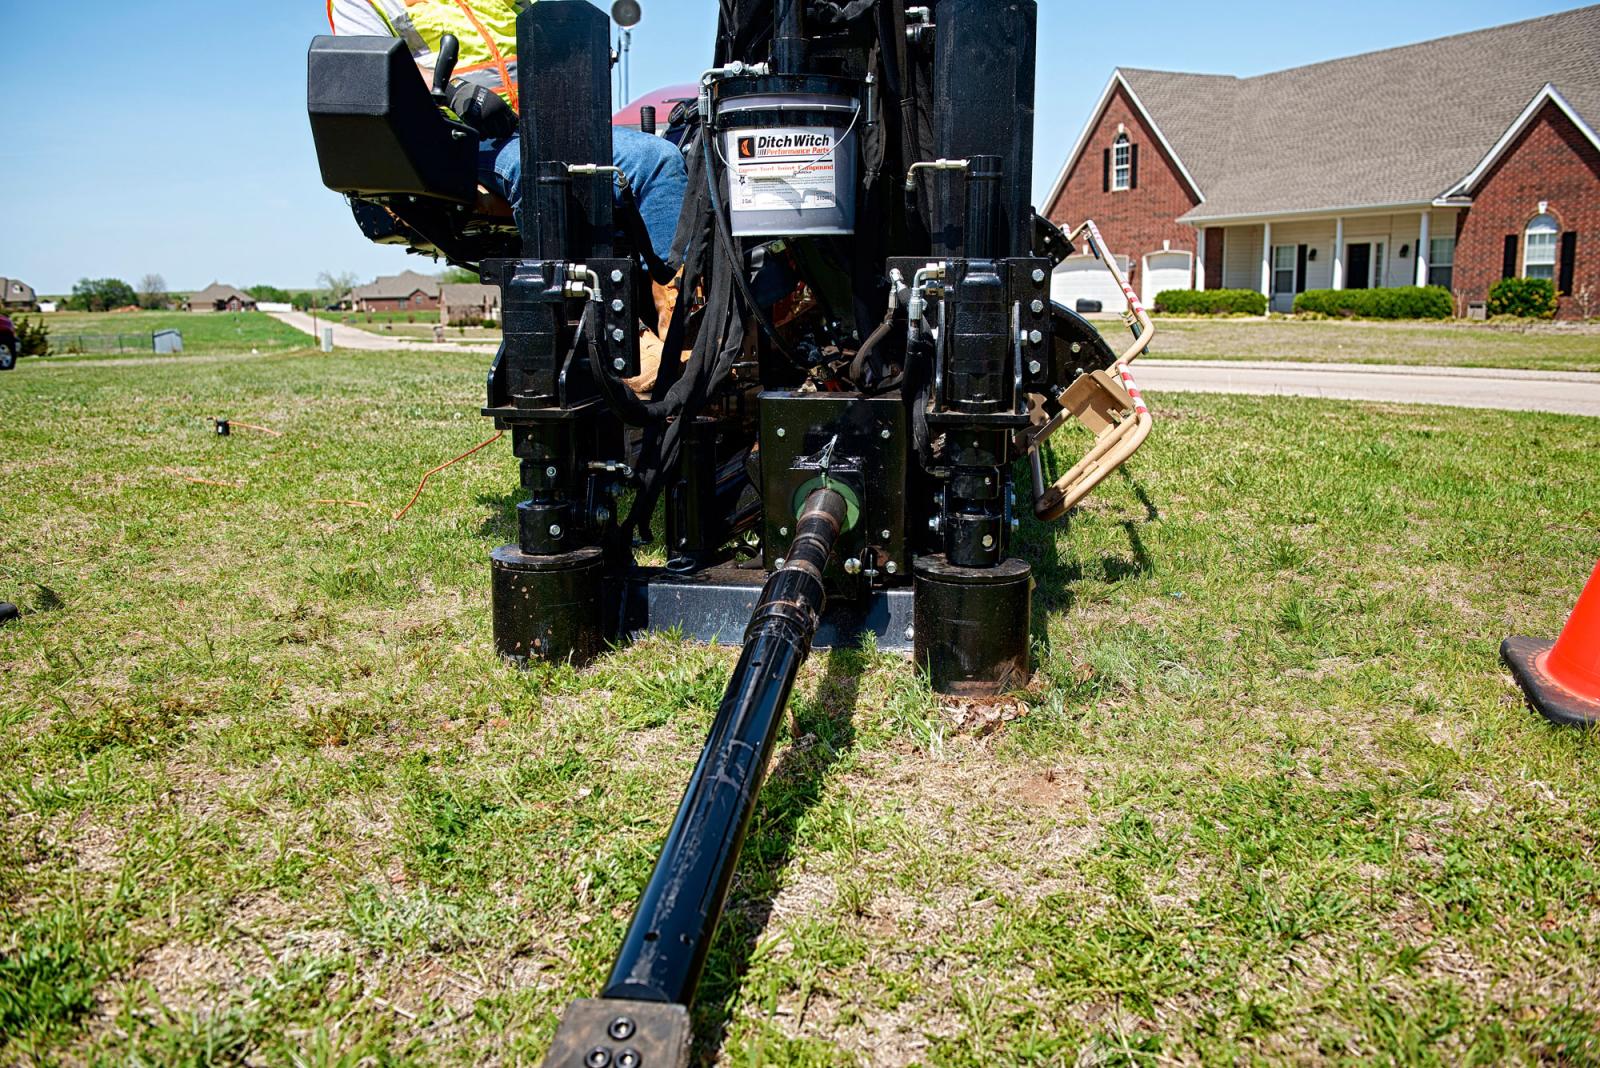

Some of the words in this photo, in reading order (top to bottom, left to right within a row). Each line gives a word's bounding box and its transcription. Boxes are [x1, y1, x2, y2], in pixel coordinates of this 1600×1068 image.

[758, 135, 792, 148] Ditch
[794, 133, 830, 147] Witch
[767, 148, 811, 156] Performance
